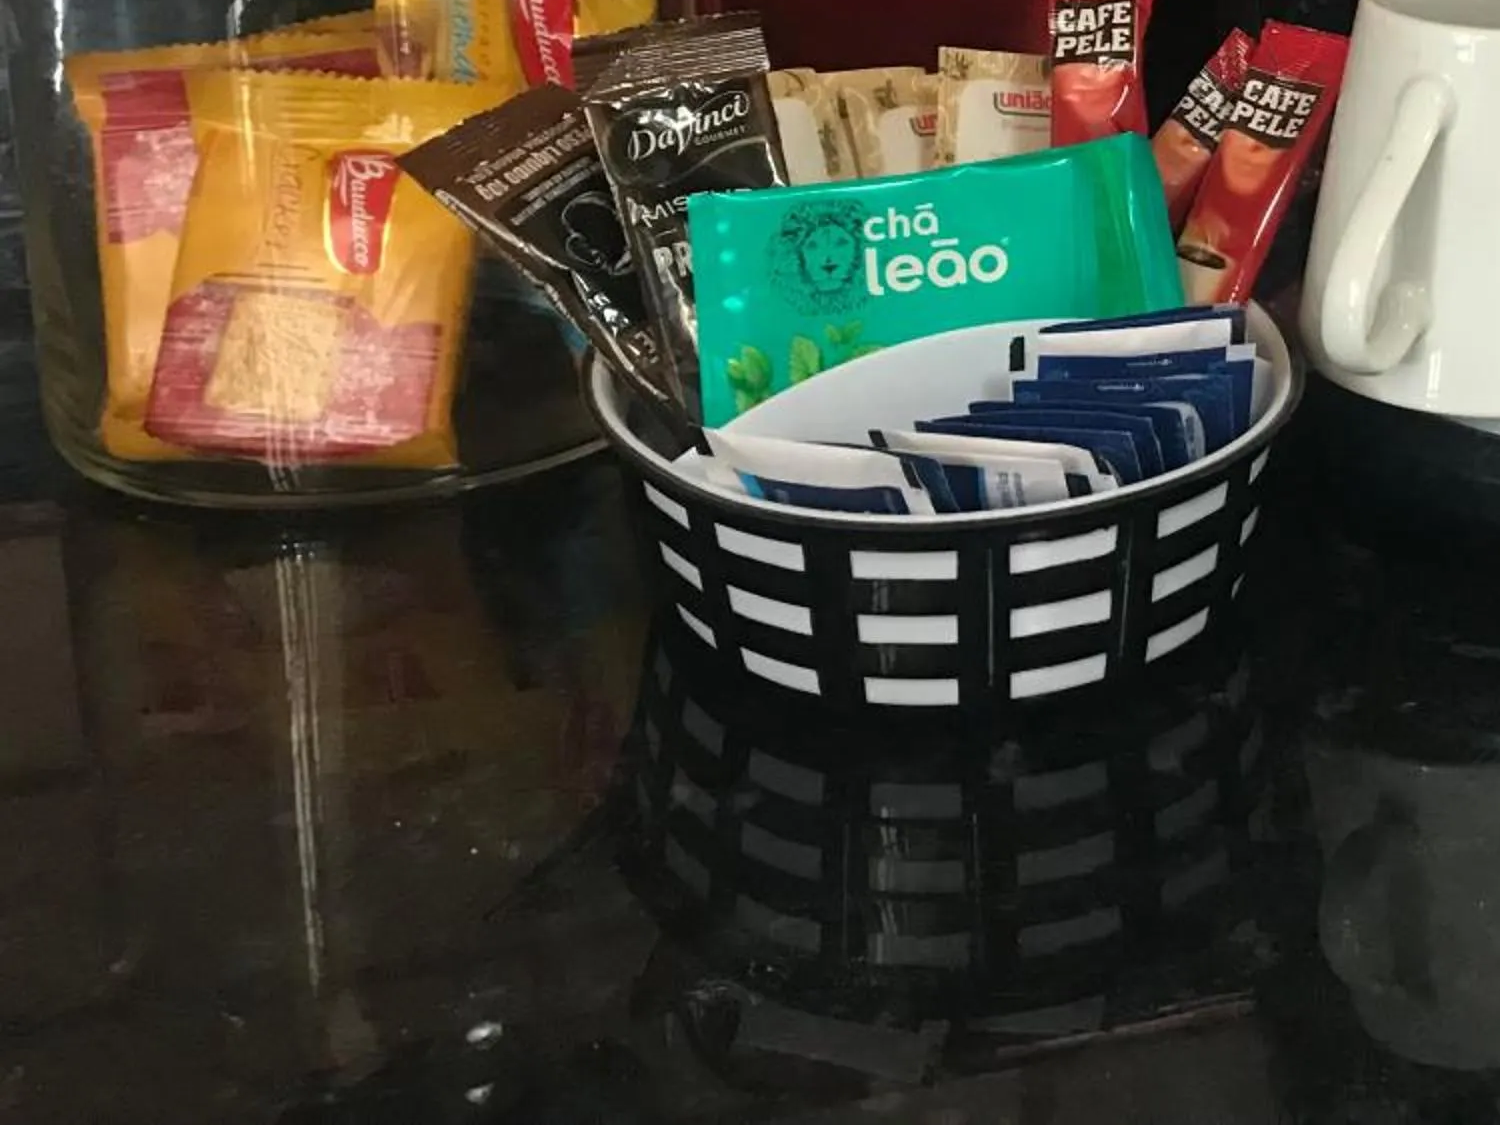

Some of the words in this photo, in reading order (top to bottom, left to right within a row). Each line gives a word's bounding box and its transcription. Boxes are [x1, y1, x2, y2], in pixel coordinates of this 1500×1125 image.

[1055, 0, 1133, 34] CAFE
[1053, 27, 1132, 59] PELE
[1242, 78, 1318, 116] CAFE
[1175, 94, 1222, 143] PEL
[1229, 99, 1305, 139] PELE
[333, 152, 396, 268] Bauducco
[864, 237, 1010, 296] leão
